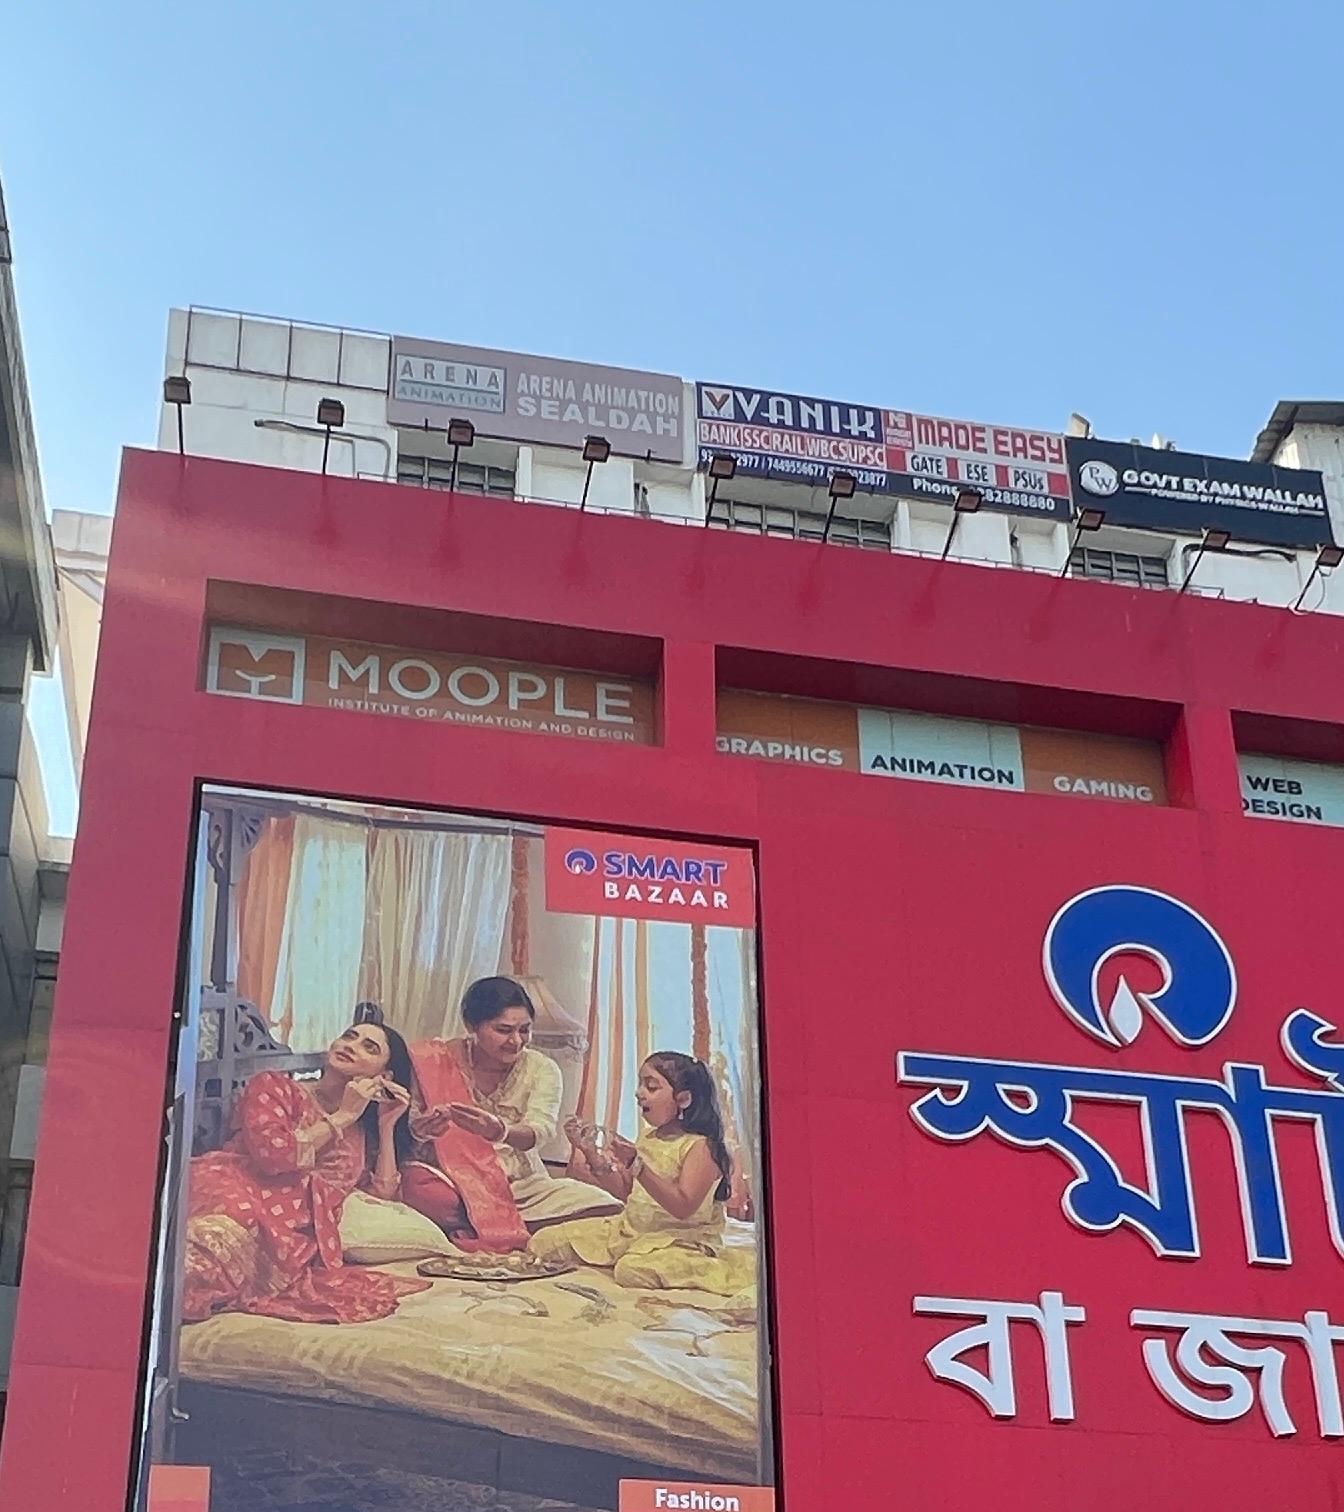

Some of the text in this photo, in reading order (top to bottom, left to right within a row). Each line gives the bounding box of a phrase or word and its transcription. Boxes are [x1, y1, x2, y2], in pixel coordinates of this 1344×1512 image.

[400, 359, 501, 389] ARENA
[398, 387, 501, 409] ANIMATION
[516, 372, 680, 416] ARENA ANIMATION
[516, 396, 678, 437] SEALDAH
[735, 391, 876, 438] VANIK
[701, 422, 885, 467] BANK SSC RAIL WBCS UPSC
[916, 418, 988, 455] MADE
[993, 429, 1065, 465] EASY
[911, 455, 944, 475] GATE
[966, 463, 989, 482] ESE
[1013, 470, 1045, 491] PSUs
[1122, 469, 1325, 510] GOVT EXAM WALLAH
[328, 650, 635, 725] MOOPLE
[328, 697, 636, 742] INSTITUTE OF ANIMATION AND DESIGN
[716, 736, 844, 766] GRAPHICS
[870, 754, 1015, 786] ANIMATION
[1246, 774, 1303, 796] WEB
[1053, 775, 1153, 802] GAMING
[603, 852, 728, 887] SMART
[604, 881, 729, 909] BAZAAR
[656, 1488, 740, 1512] Fashion
